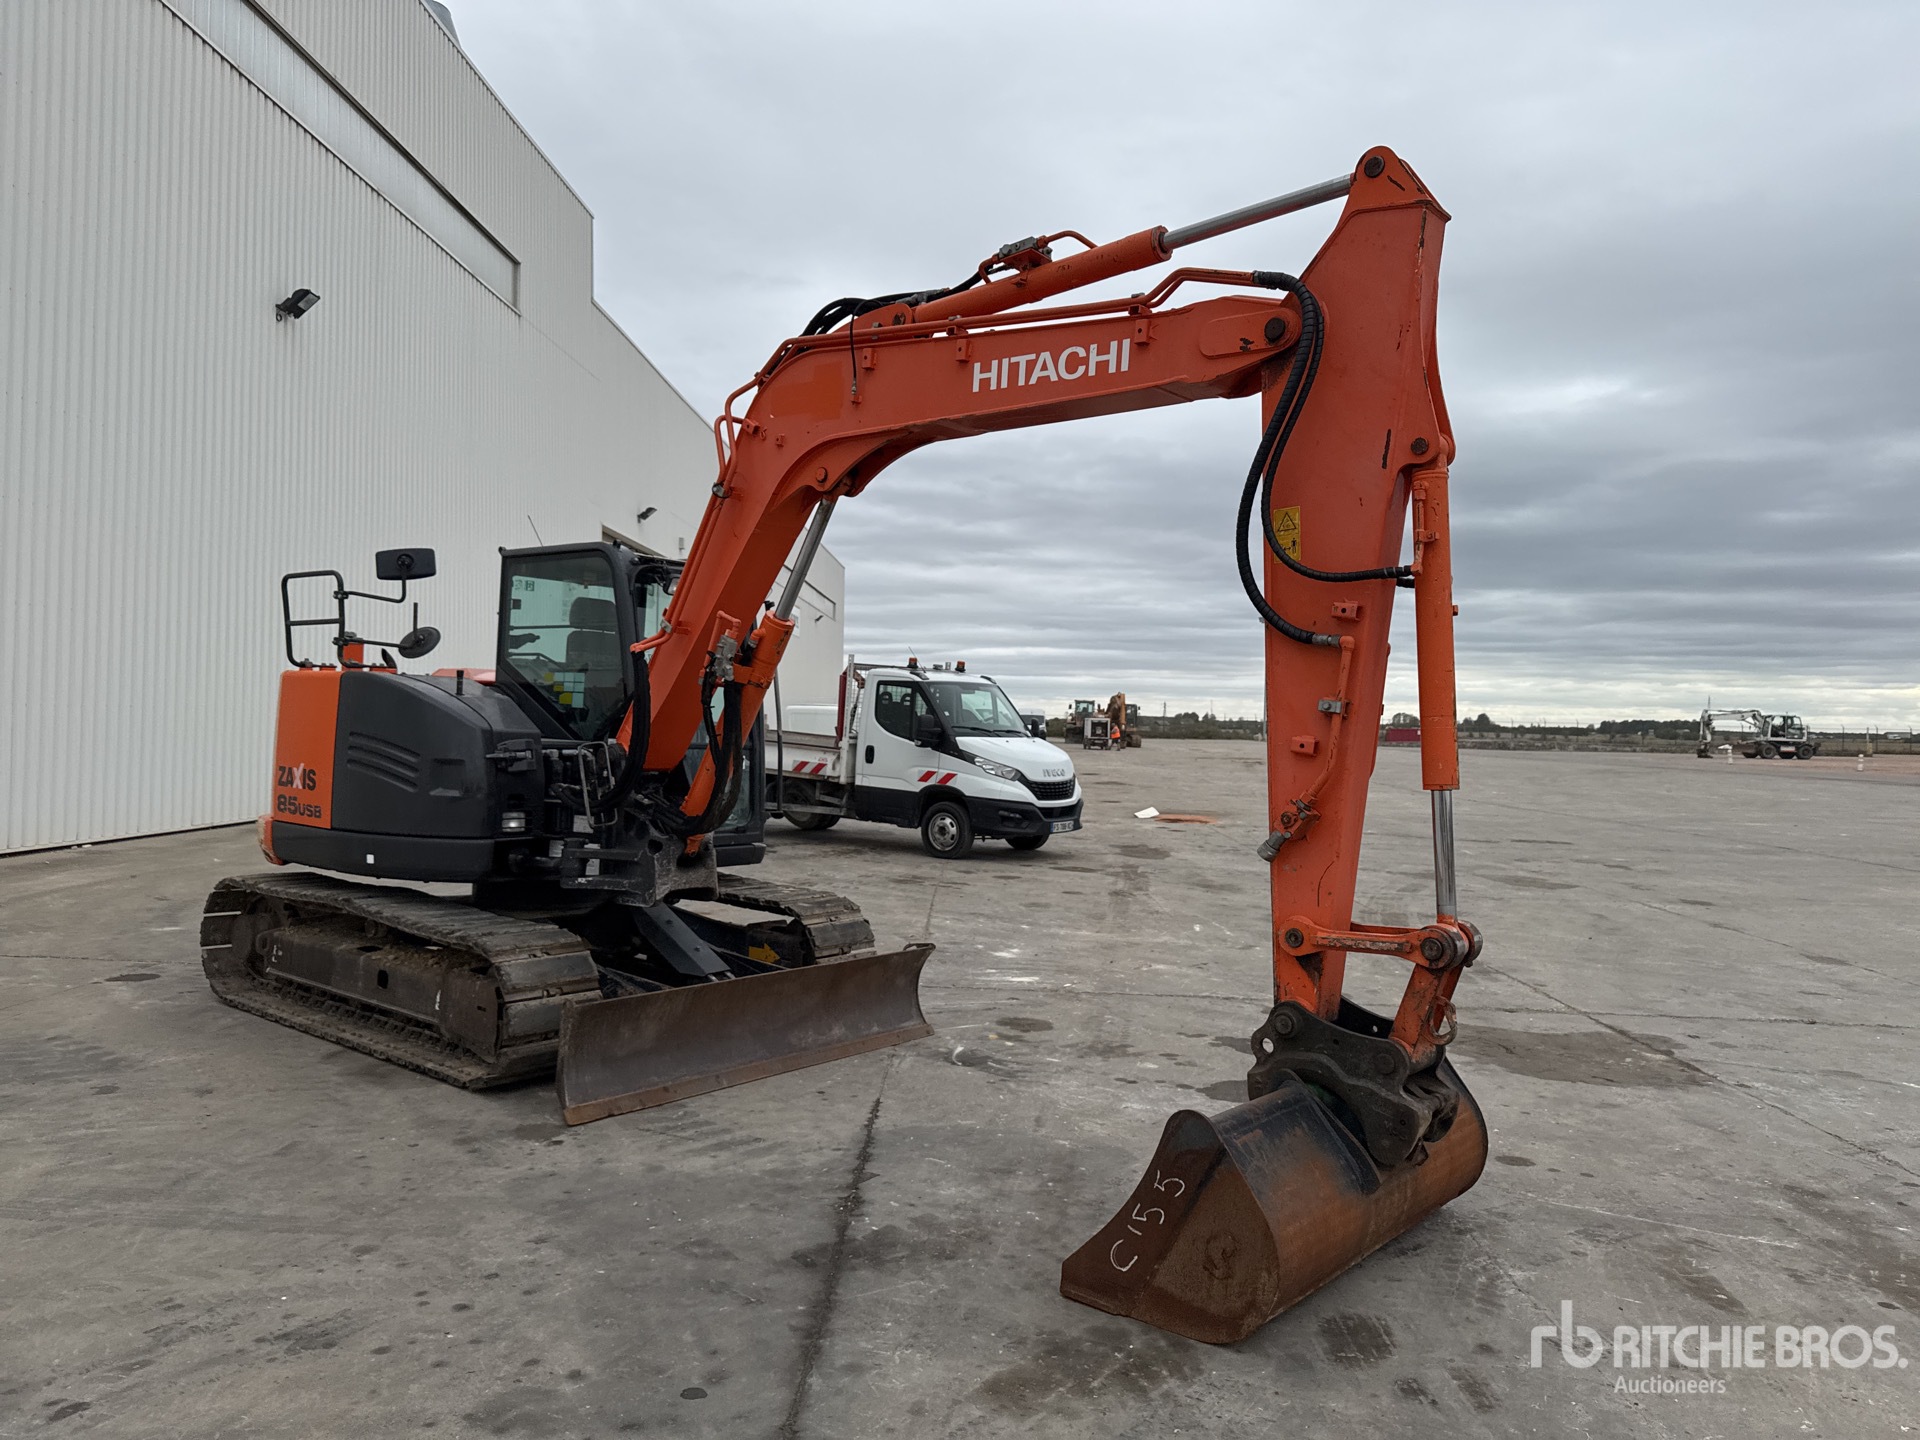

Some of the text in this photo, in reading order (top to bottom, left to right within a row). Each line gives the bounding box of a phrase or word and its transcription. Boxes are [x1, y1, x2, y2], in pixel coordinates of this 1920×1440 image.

[972, 338, 1131, 393] HITACHI
[278, 763, 317, 791] ZAXIS
[1042, 769, 1066, 778] IVECO
[1110, 1169, 1185, 1272] C155
